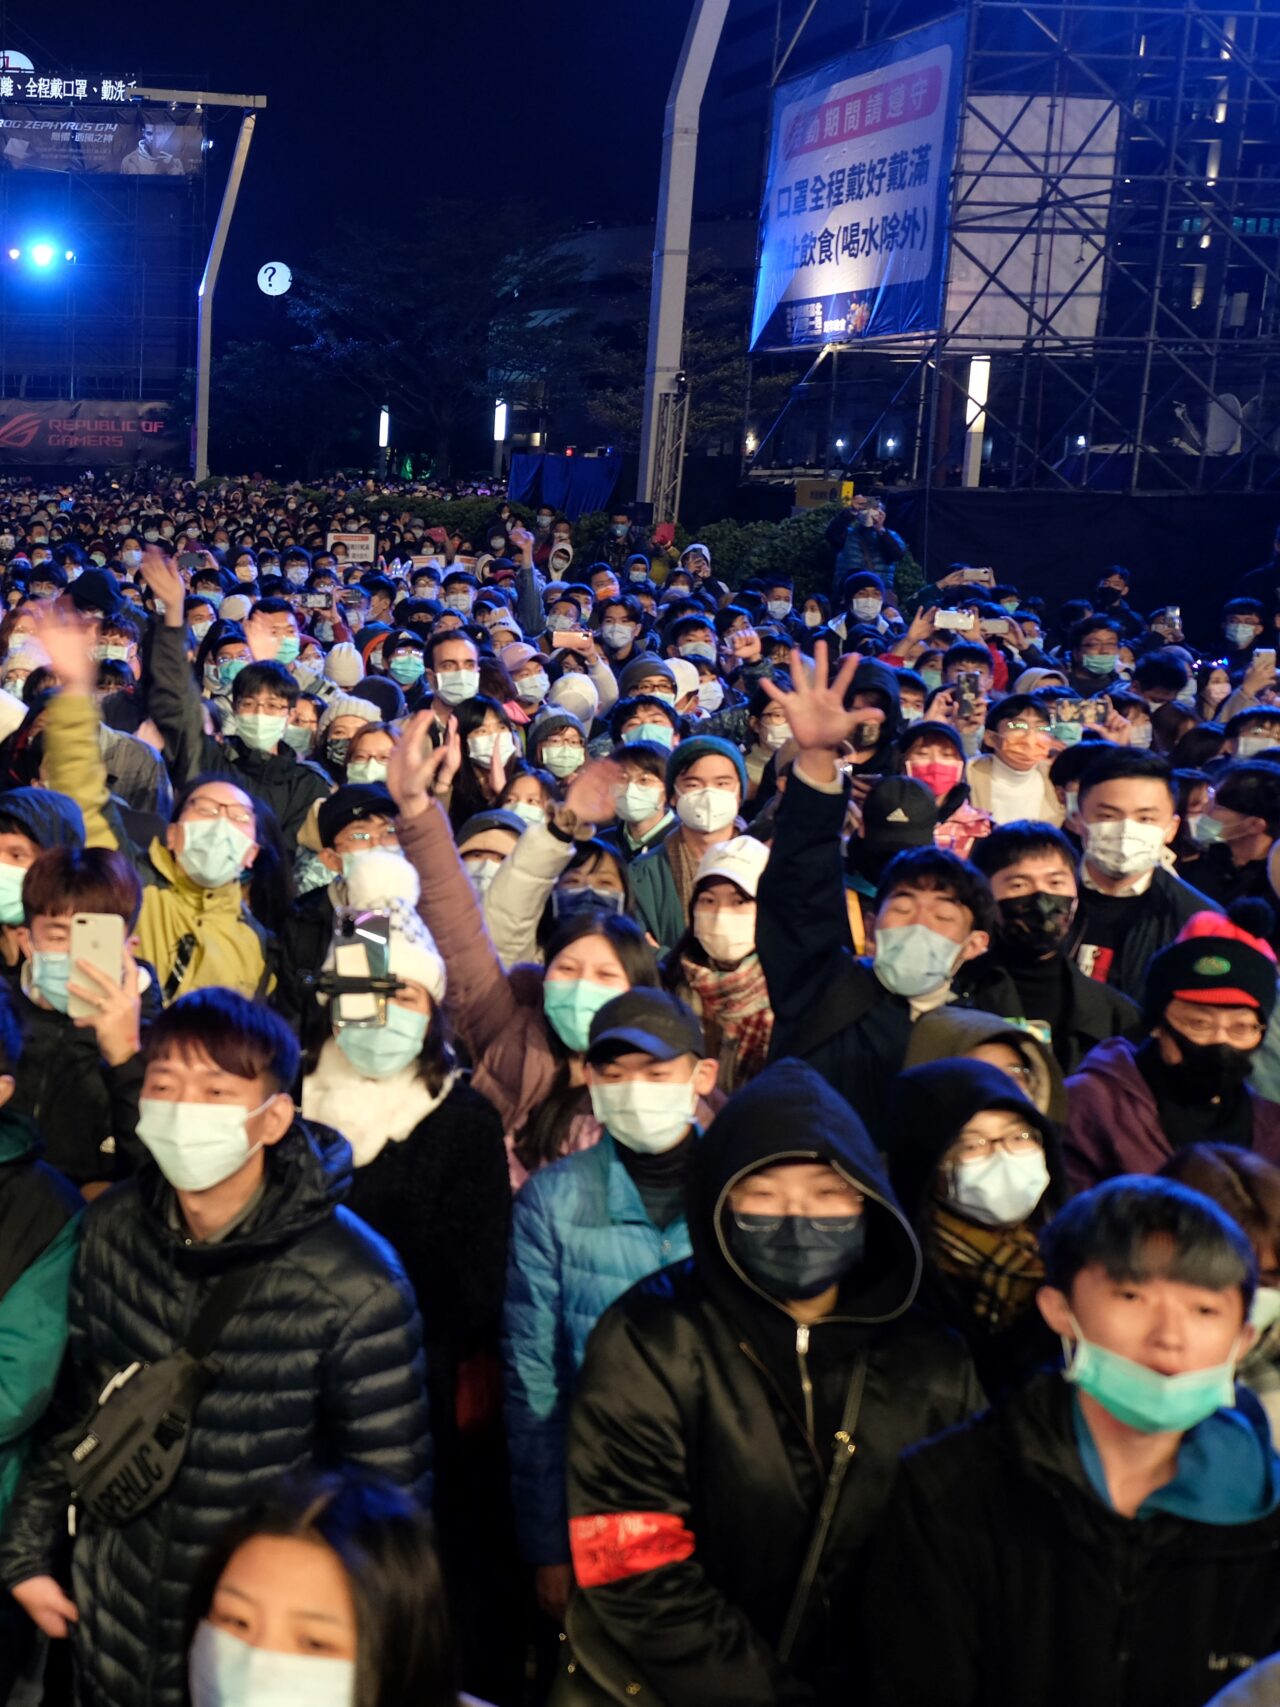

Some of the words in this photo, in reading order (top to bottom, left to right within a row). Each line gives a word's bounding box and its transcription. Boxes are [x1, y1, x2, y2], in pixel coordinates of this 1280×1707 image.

[24, 121, 93, 132] ZEPHYRUS
[777, 143, 932, 219] 口罩全程戴好戴滿
[775, 206, 928, 270] 止飲食(喝水除外)
[48, 419, 137, 432] REPUBLIC
[141, 420, 164, 433] OF
[48, 434, 124, 448] GAMERS
